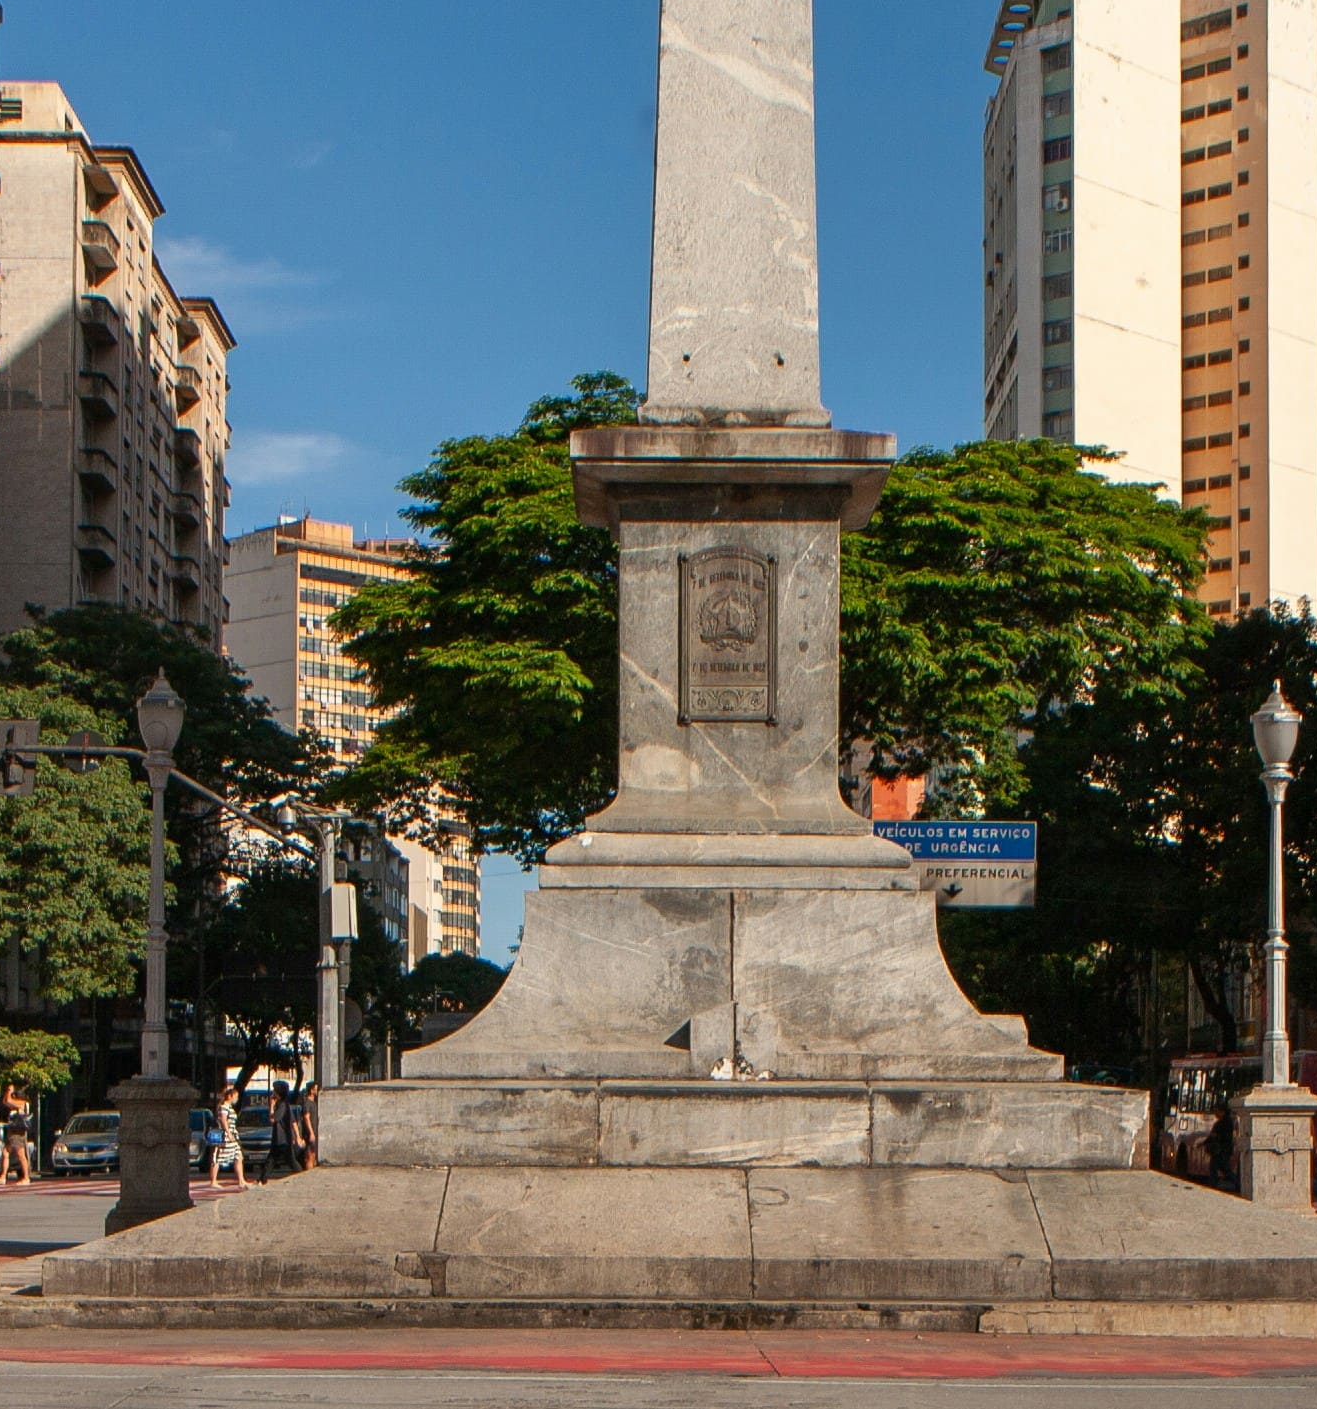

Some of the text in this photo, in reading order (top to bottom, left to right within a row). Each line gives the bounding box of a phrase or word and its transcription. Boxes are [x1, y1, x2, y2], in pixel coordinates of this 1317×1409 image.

[877, 823, 1031, 840] VEÍCULOS EM SERVIÇO
[905, 840, 1001, 854] DE URGÊNCIA
[926, 868, 1029, 879] PREFERENCIAL
